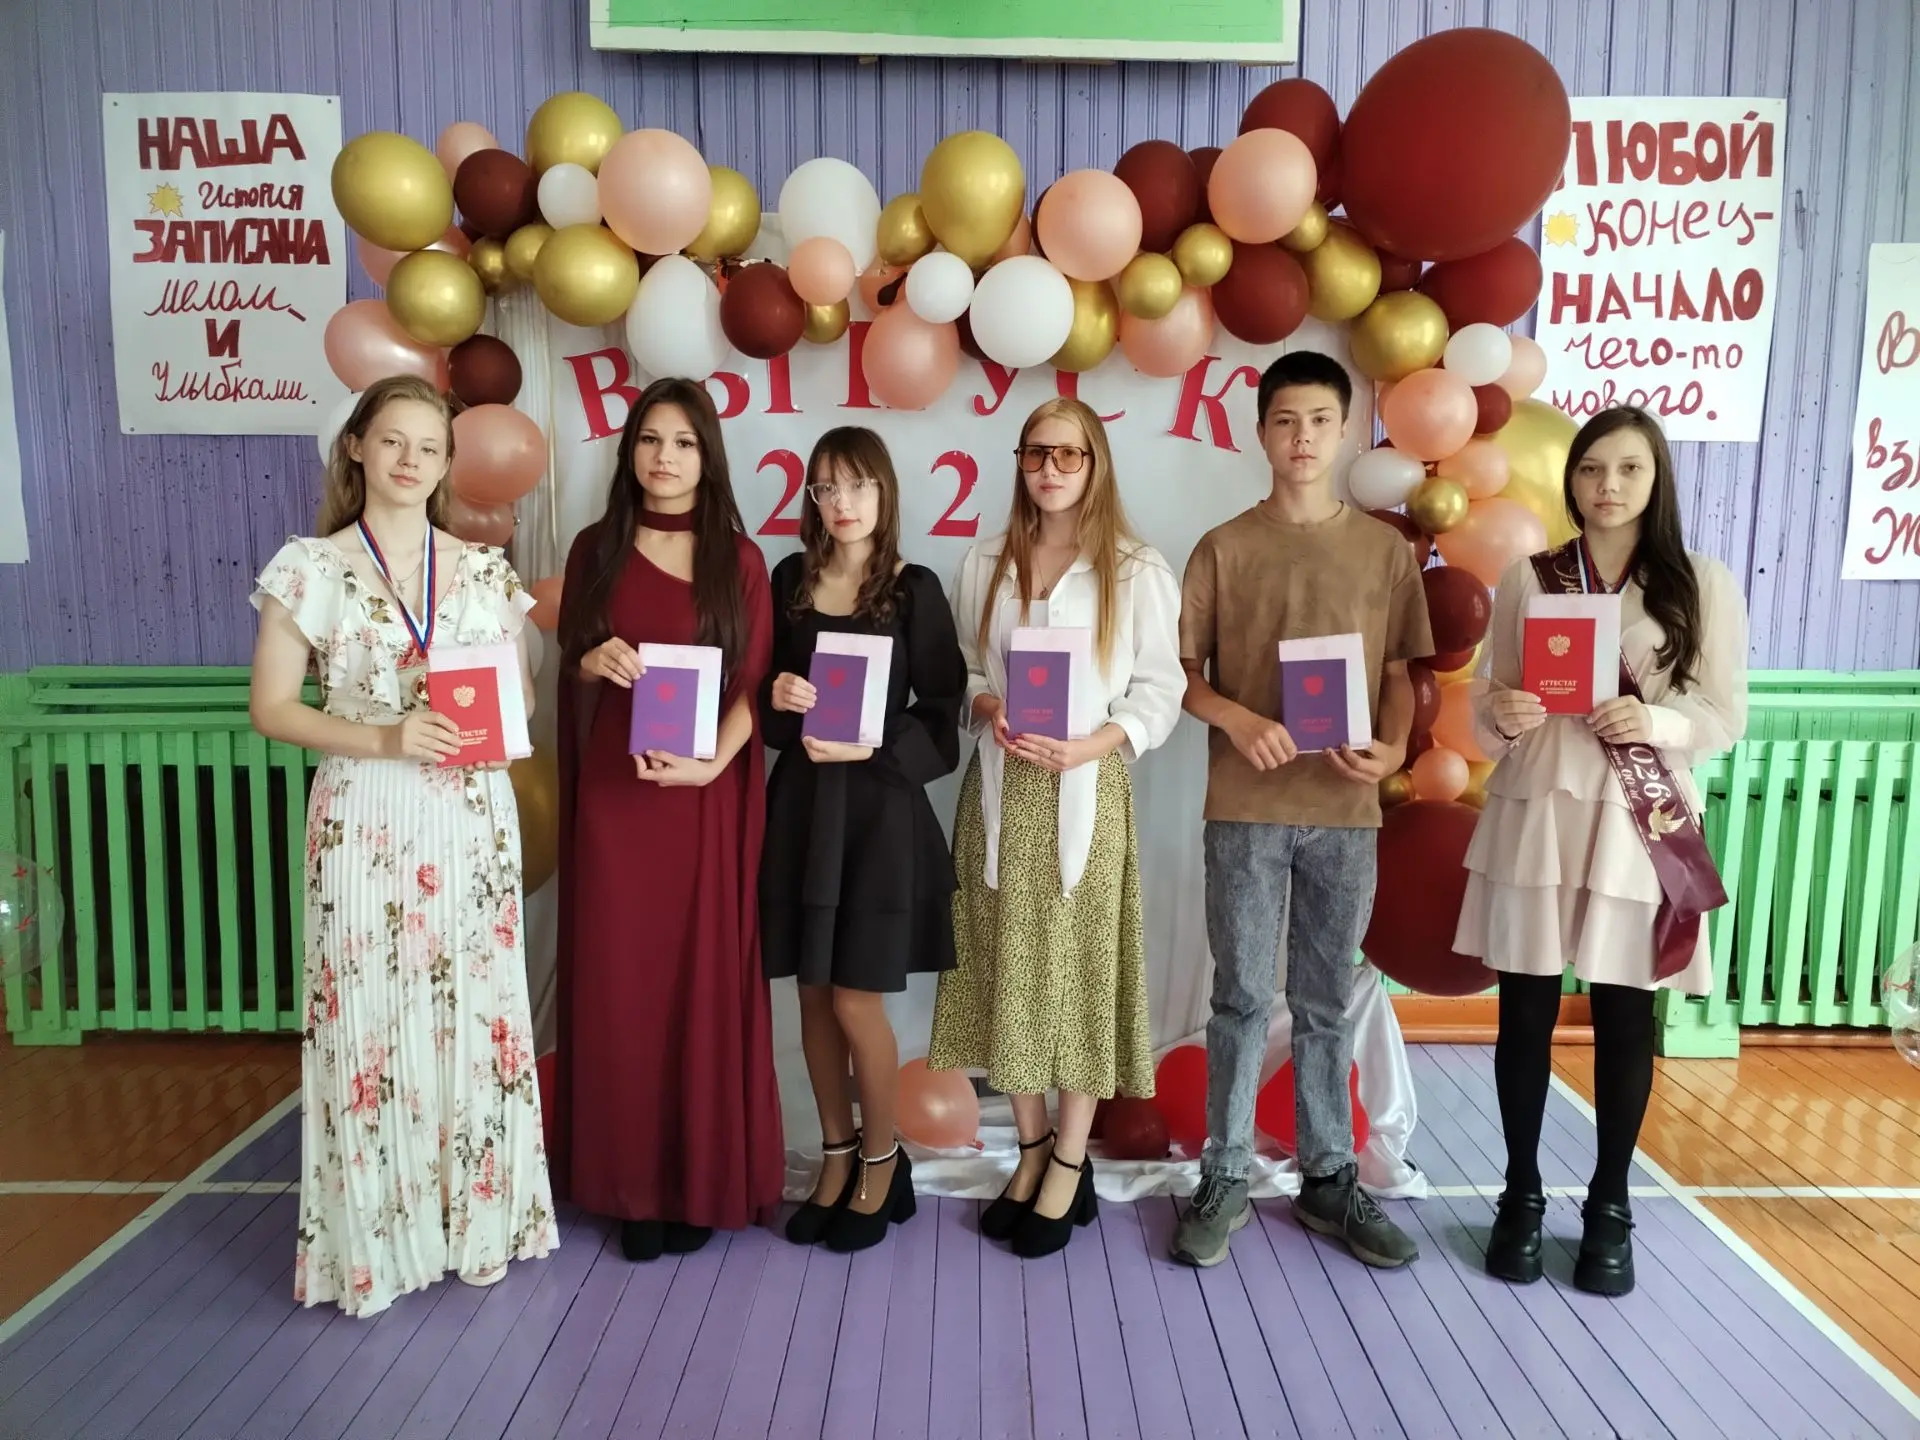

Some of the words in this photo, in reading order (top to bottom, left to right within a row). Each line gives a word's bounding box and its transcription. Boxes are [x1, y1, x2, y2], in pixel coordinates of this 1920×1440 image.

[137, 113, 306, 170] НАША
[132, 218, 331, 265] ЗАПИСАНА
[1549, 267, 1764, 324] НАЧАЛО
[1628, 746, 1672, 799] 026
